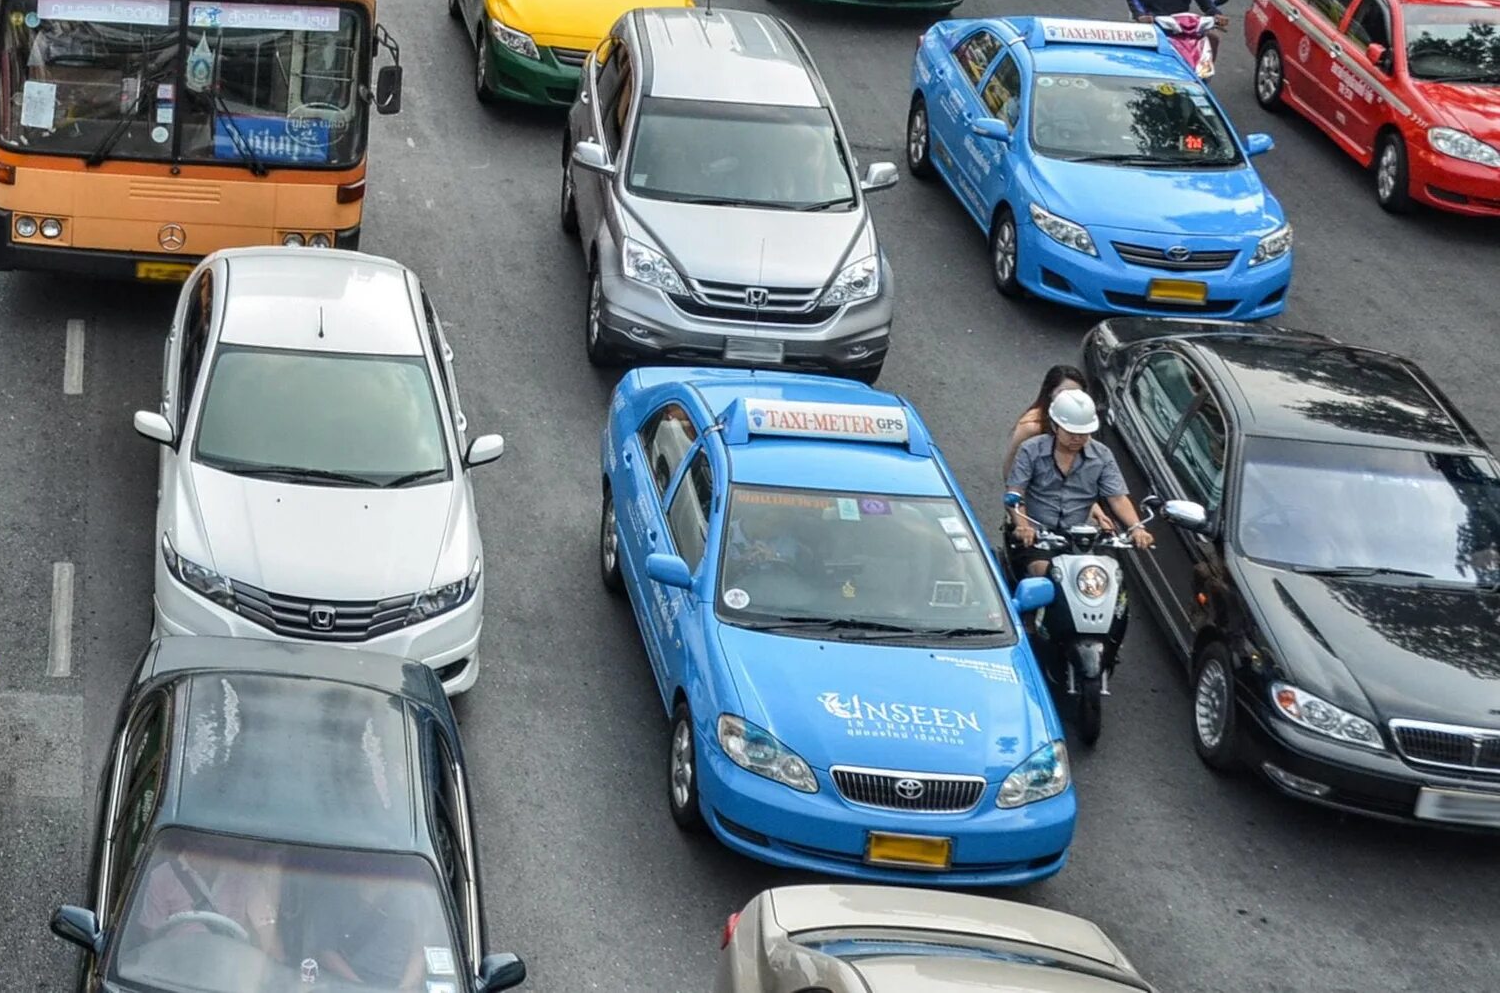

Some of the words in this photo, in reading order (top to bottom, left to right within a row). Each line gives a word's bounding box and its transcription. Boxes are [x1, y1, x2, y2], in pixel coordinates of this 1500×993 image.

[1059, 26, 1135, 43] TAXI-METER
[765, 410, 876, 434] TAXI-METER
[876, 417, 904, 431] GPS
[817, 692, 982, 732] UNSEEN
